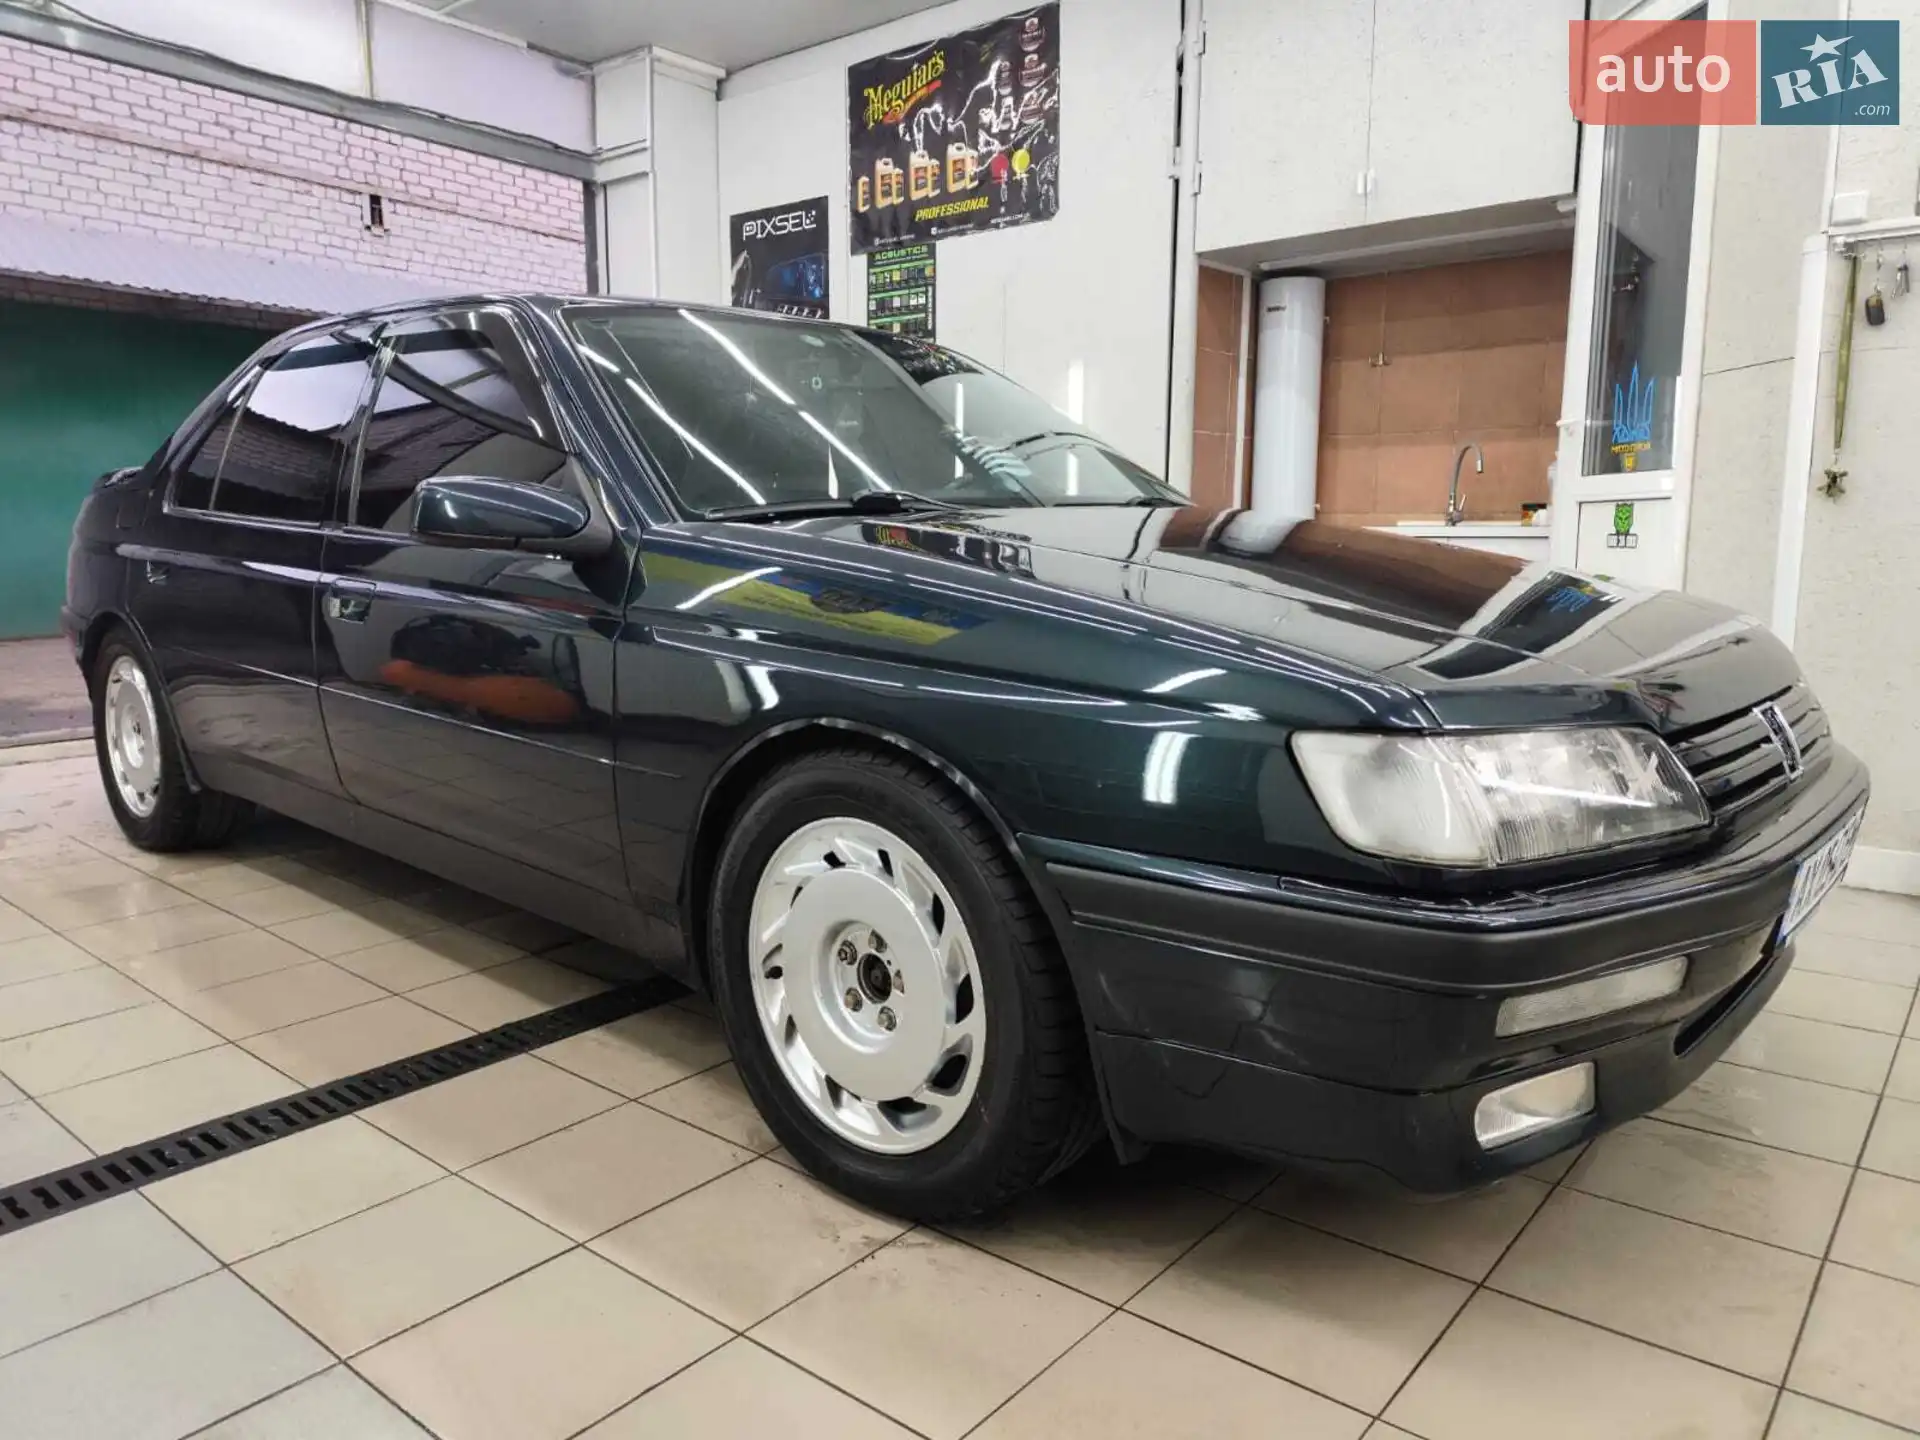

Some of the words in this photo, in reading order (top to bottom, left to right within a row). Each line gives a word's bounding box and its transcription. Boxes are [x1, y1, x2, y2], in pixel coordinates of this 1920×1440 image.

[864, 50, 945, 129] Meguiar's
[915, 196, 989, 222] PROFESSIONAL
[742, 209, 816, 240] PIXSEL
[875, 246, 928, 260] ACOUSTICS
